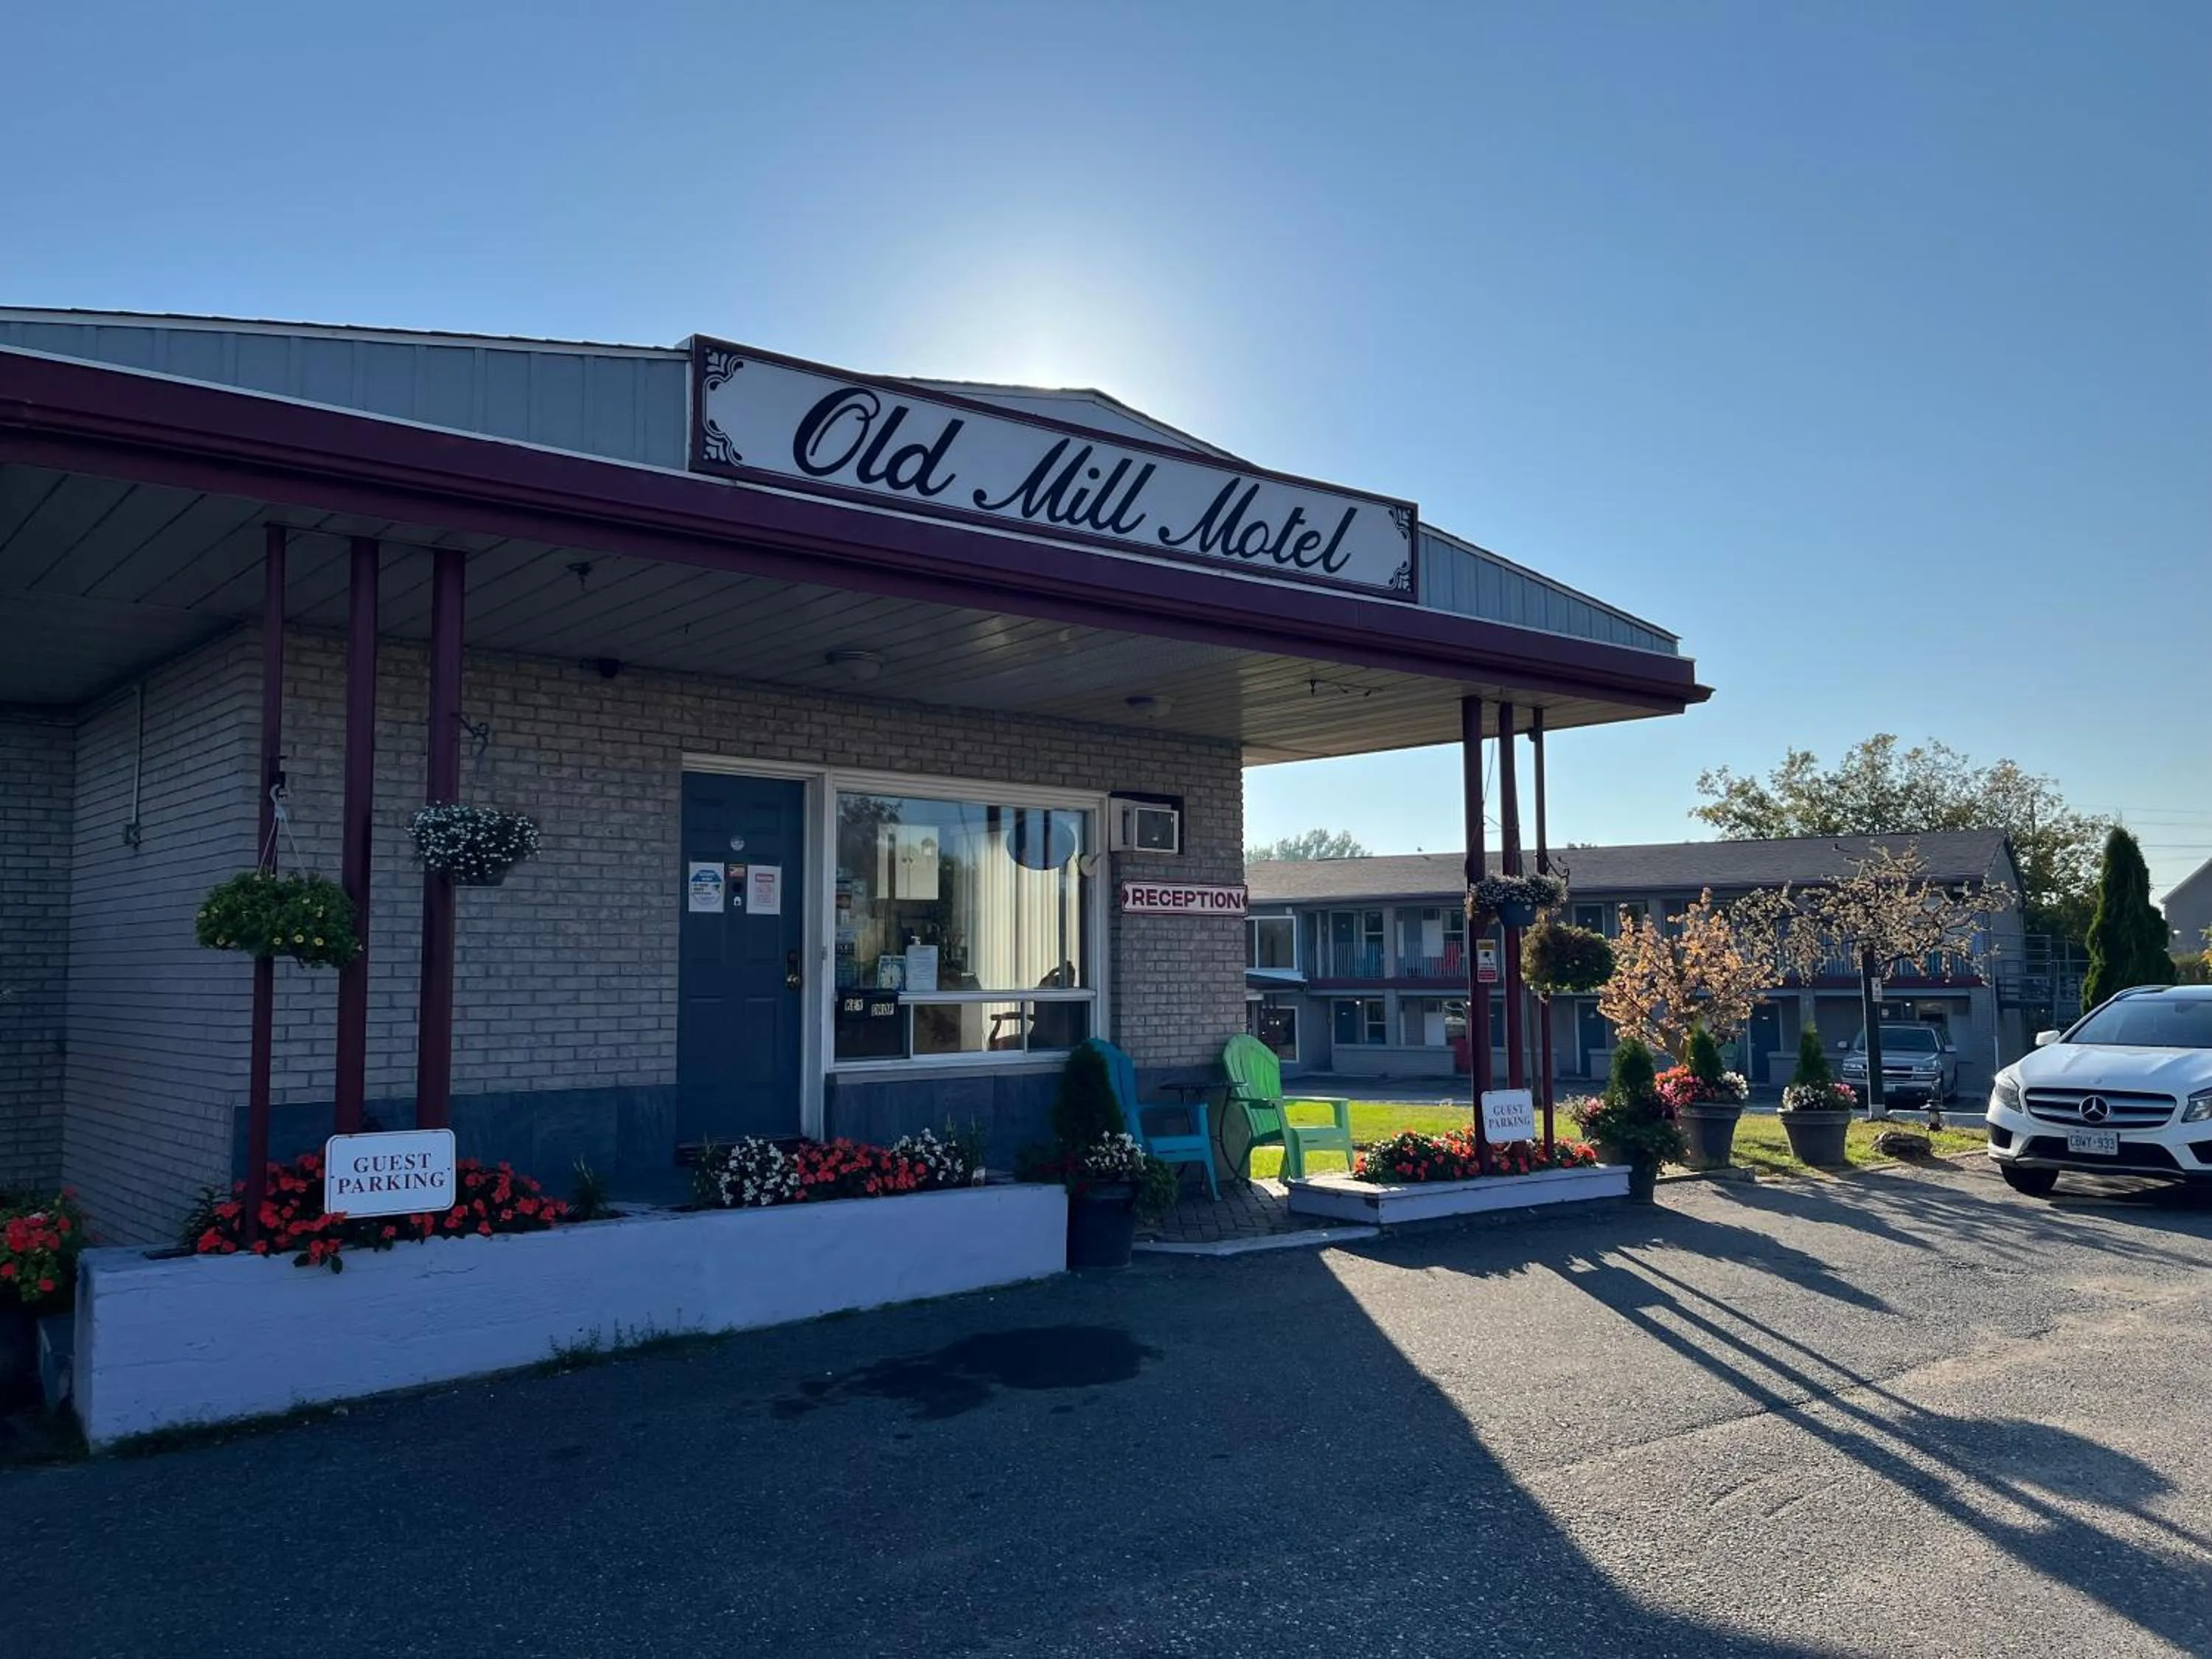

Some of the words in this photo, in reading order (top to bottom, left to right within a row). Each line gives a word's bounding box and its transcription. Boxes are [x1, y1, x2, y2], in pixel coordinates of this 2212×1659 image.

[792, 386, 965, 497] Old
[973, 437, 1157, 535] Mill
[1157, 477, 1359, 574] Motel
[1132, 888, 1241, 909] RECEPTION
[1493, 1104, 1523, 1116] GUEST
[1488, 1115, 1531, 1129] PARKING
[353, 1152, 431, 1173] GUEST
[337, 1172, 445, 1194] PARKING
